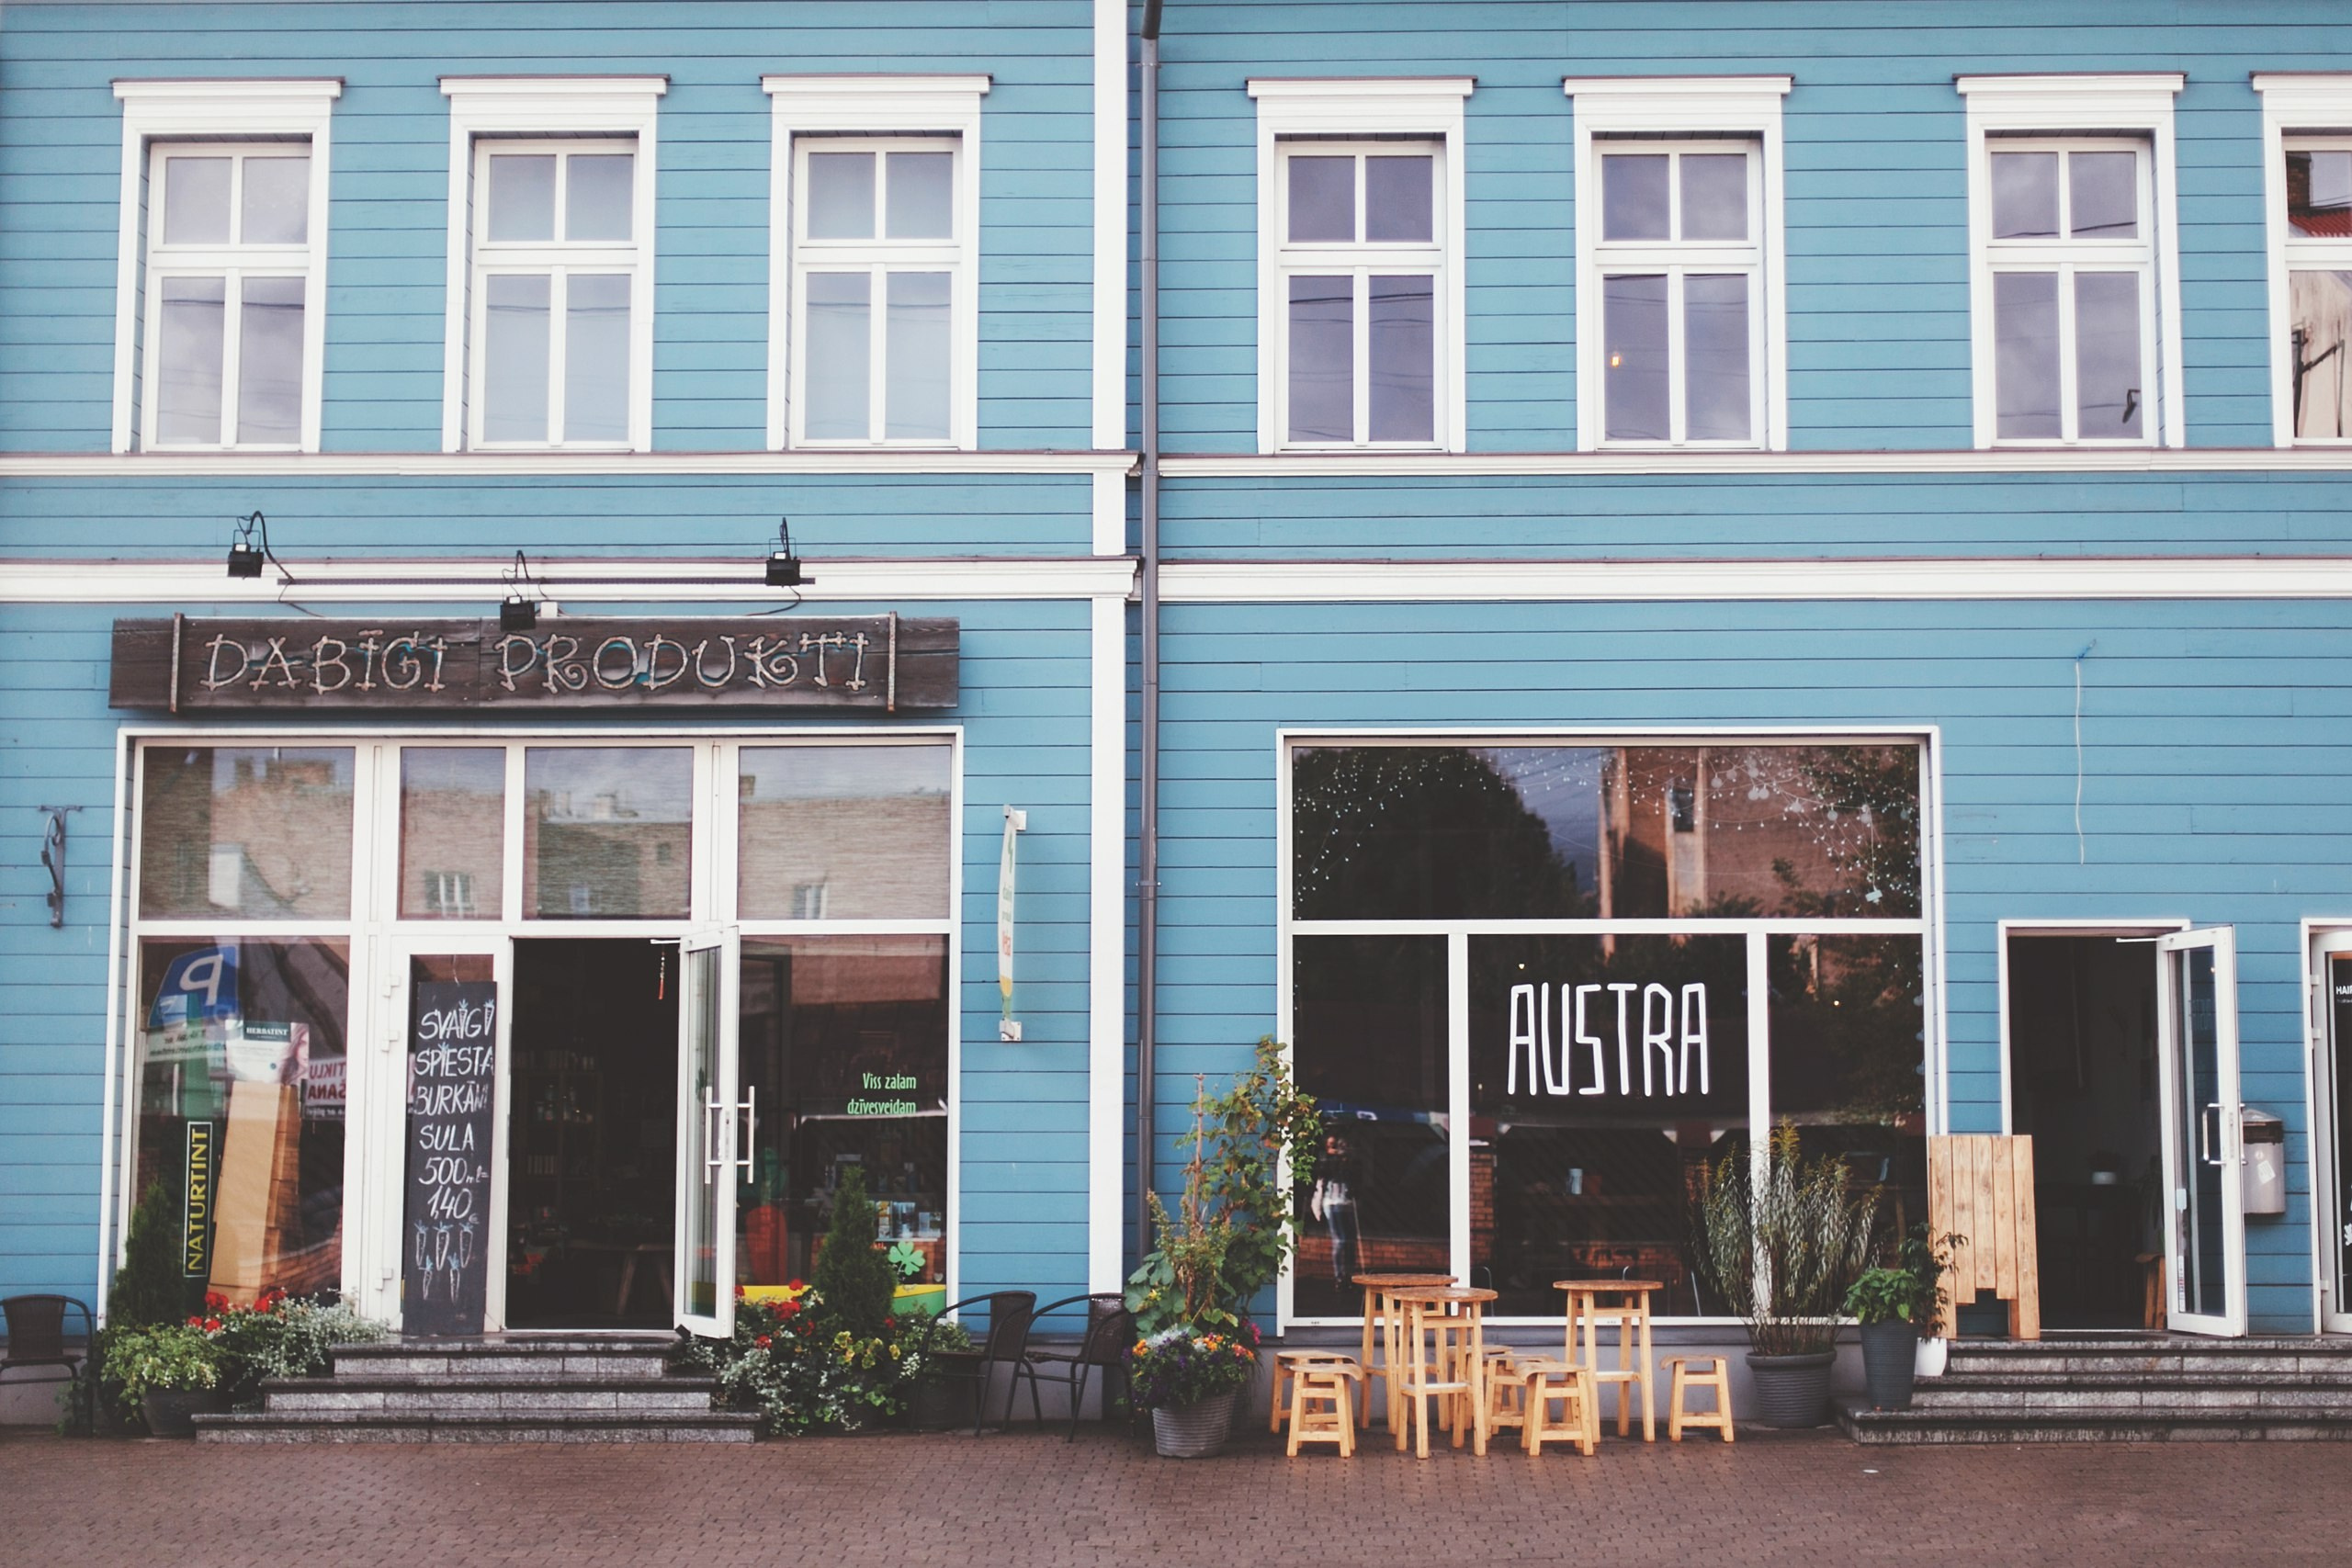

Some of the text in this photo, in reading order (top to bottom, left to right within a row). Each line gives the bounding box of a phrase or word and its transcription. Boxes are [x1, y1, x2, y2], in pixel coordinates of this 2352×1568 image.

[199, 629, 869, 695] DABĪGI PRODUKTI
[246, 1026, 289, 1036] HERBATINT
[1507, 981, 1709, 1097] AUSTRA
[414, 1045, 494, 1077] SPIESTA
[863, 1072, 882, 1089] Viss
[847, 1098, 917, 1114] dzīvesveidam
[419, 1122, 474, 1152] SULA
[187, 1128, 208, 1270] NATURTINT
